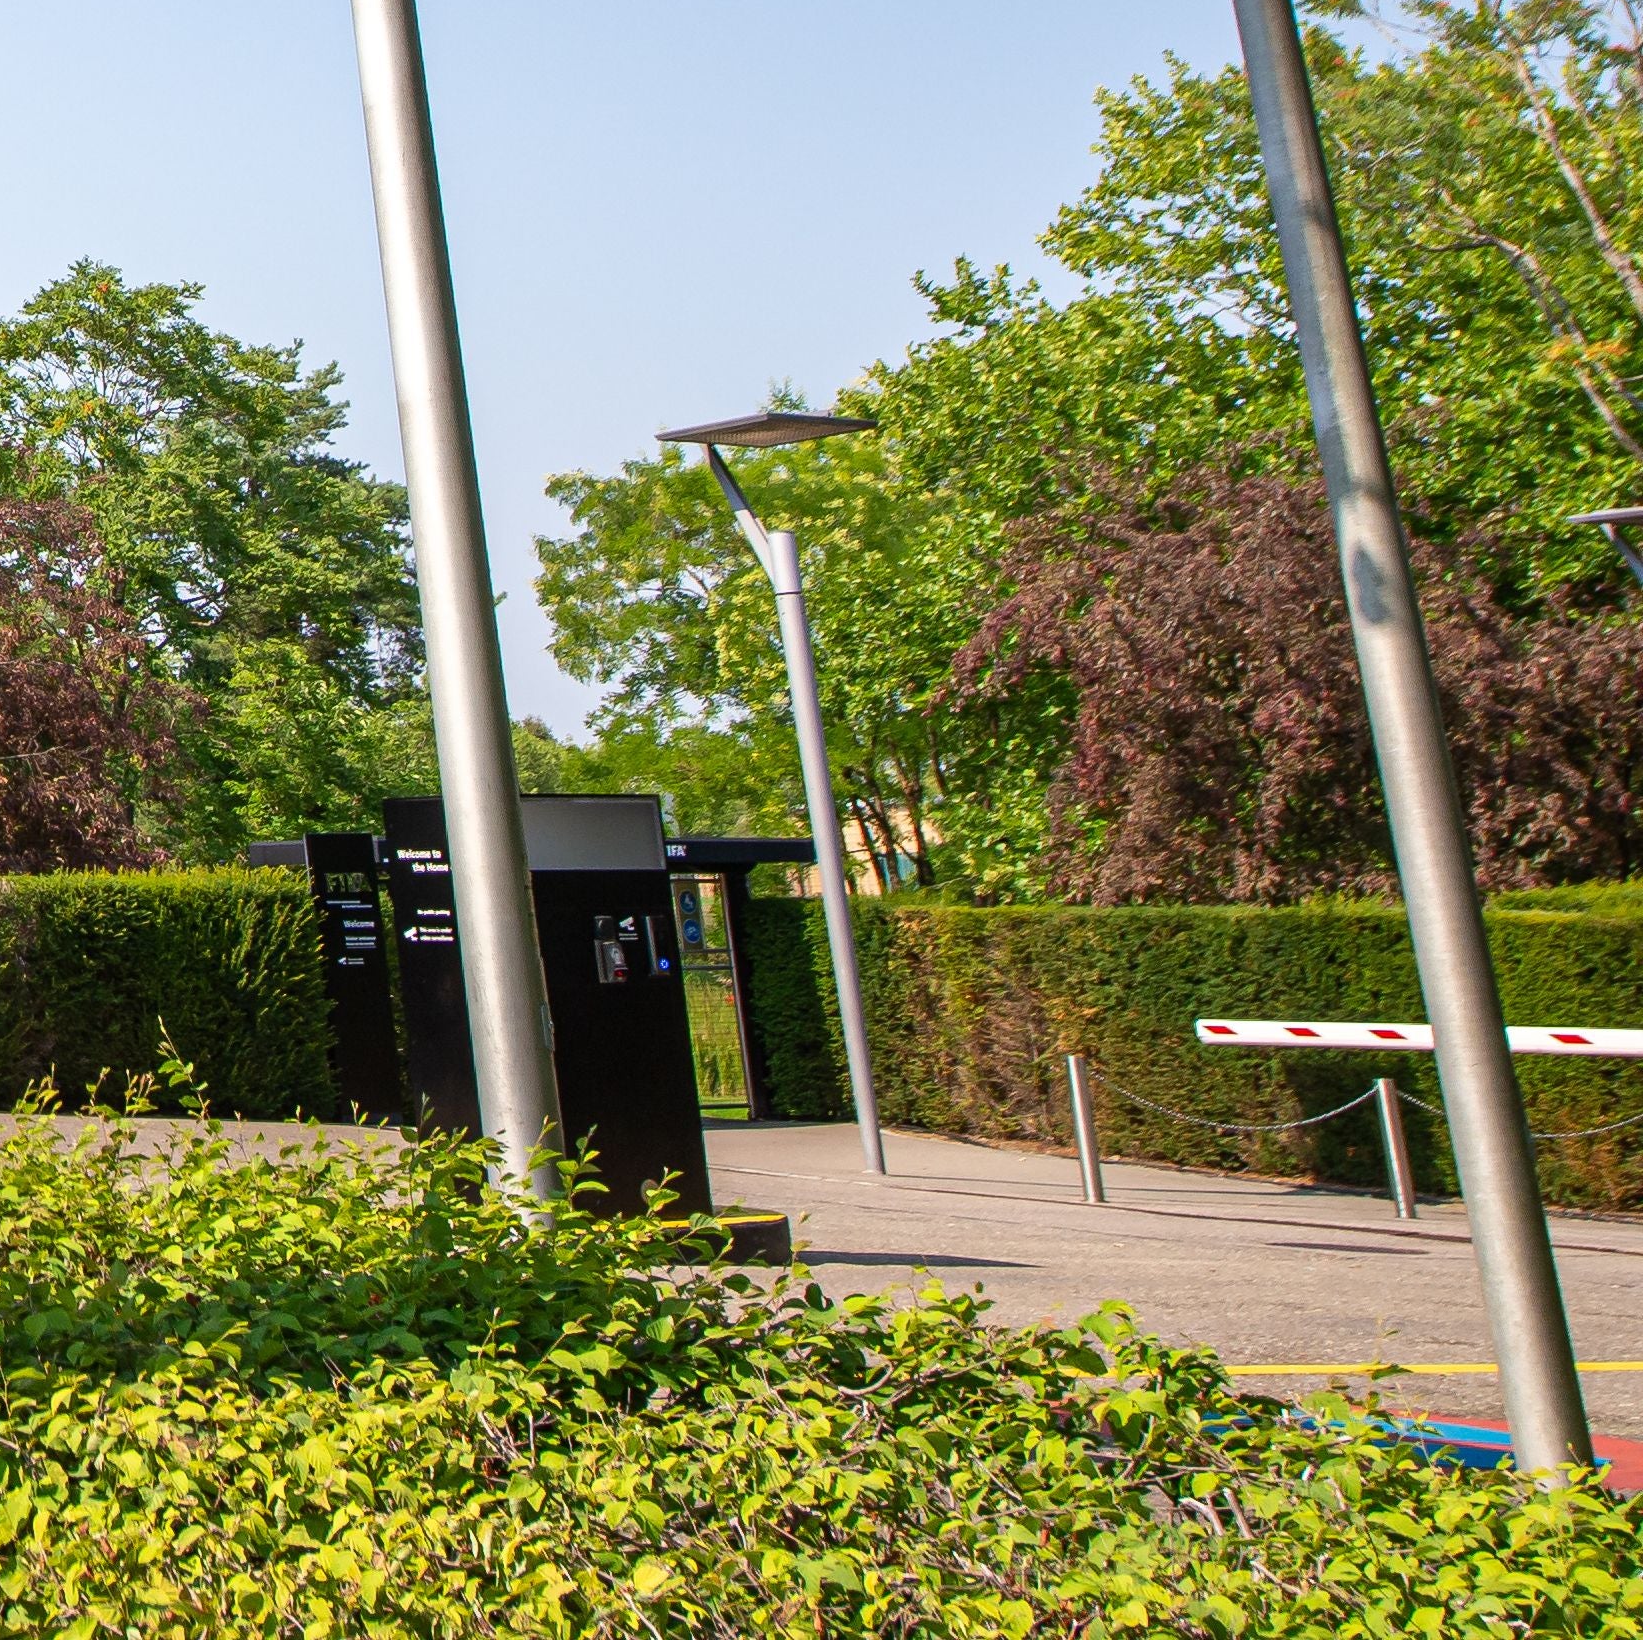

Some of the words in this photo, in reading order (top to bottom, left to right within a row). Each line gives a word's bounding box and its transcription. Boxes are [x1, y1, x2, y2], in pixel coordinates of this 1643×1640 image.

[396, 849, 431, 859] Welcome
[432, 849, 442, 859] to
[666, 845, 686, 857] IFA
[412, 862, 425, 872] the
[426, 862, 449, 872] Home
